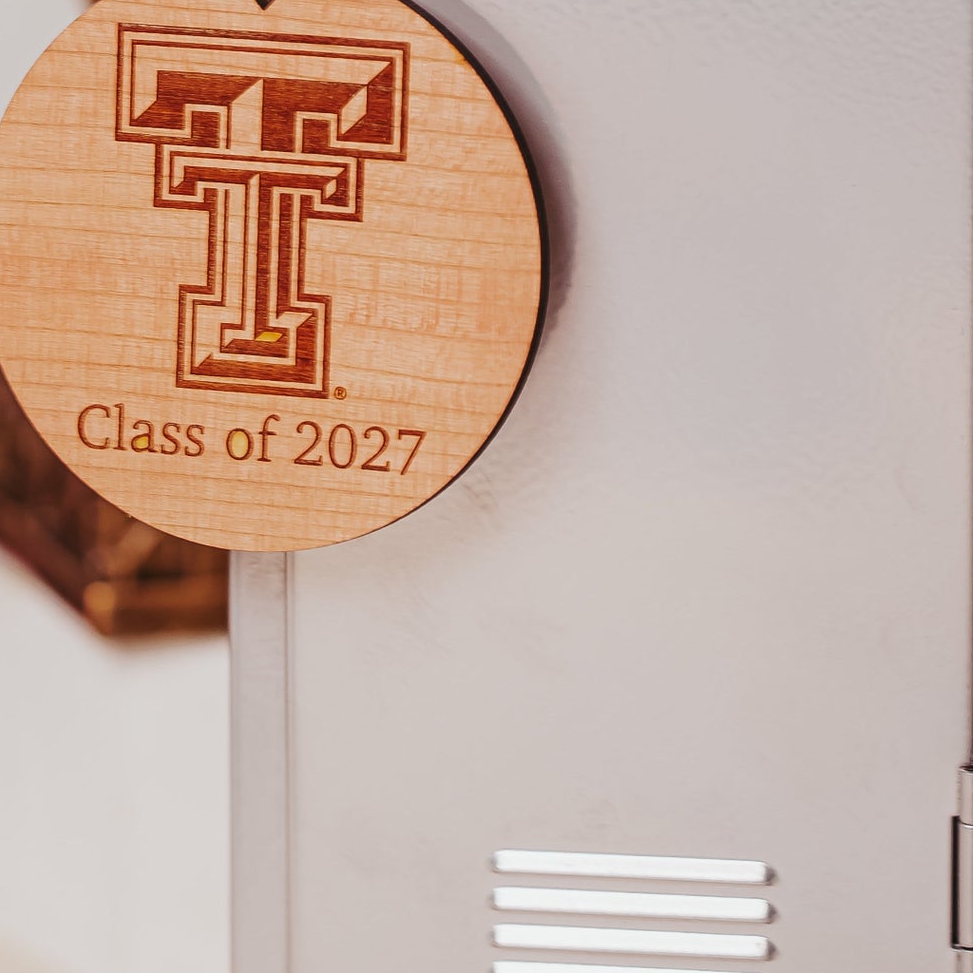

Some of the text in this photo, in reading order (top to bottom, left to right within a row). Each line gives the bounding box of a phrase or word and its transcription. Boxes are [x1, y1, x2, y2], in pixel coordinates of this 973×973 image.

[76, 402, 428, 476] Class of 2027
